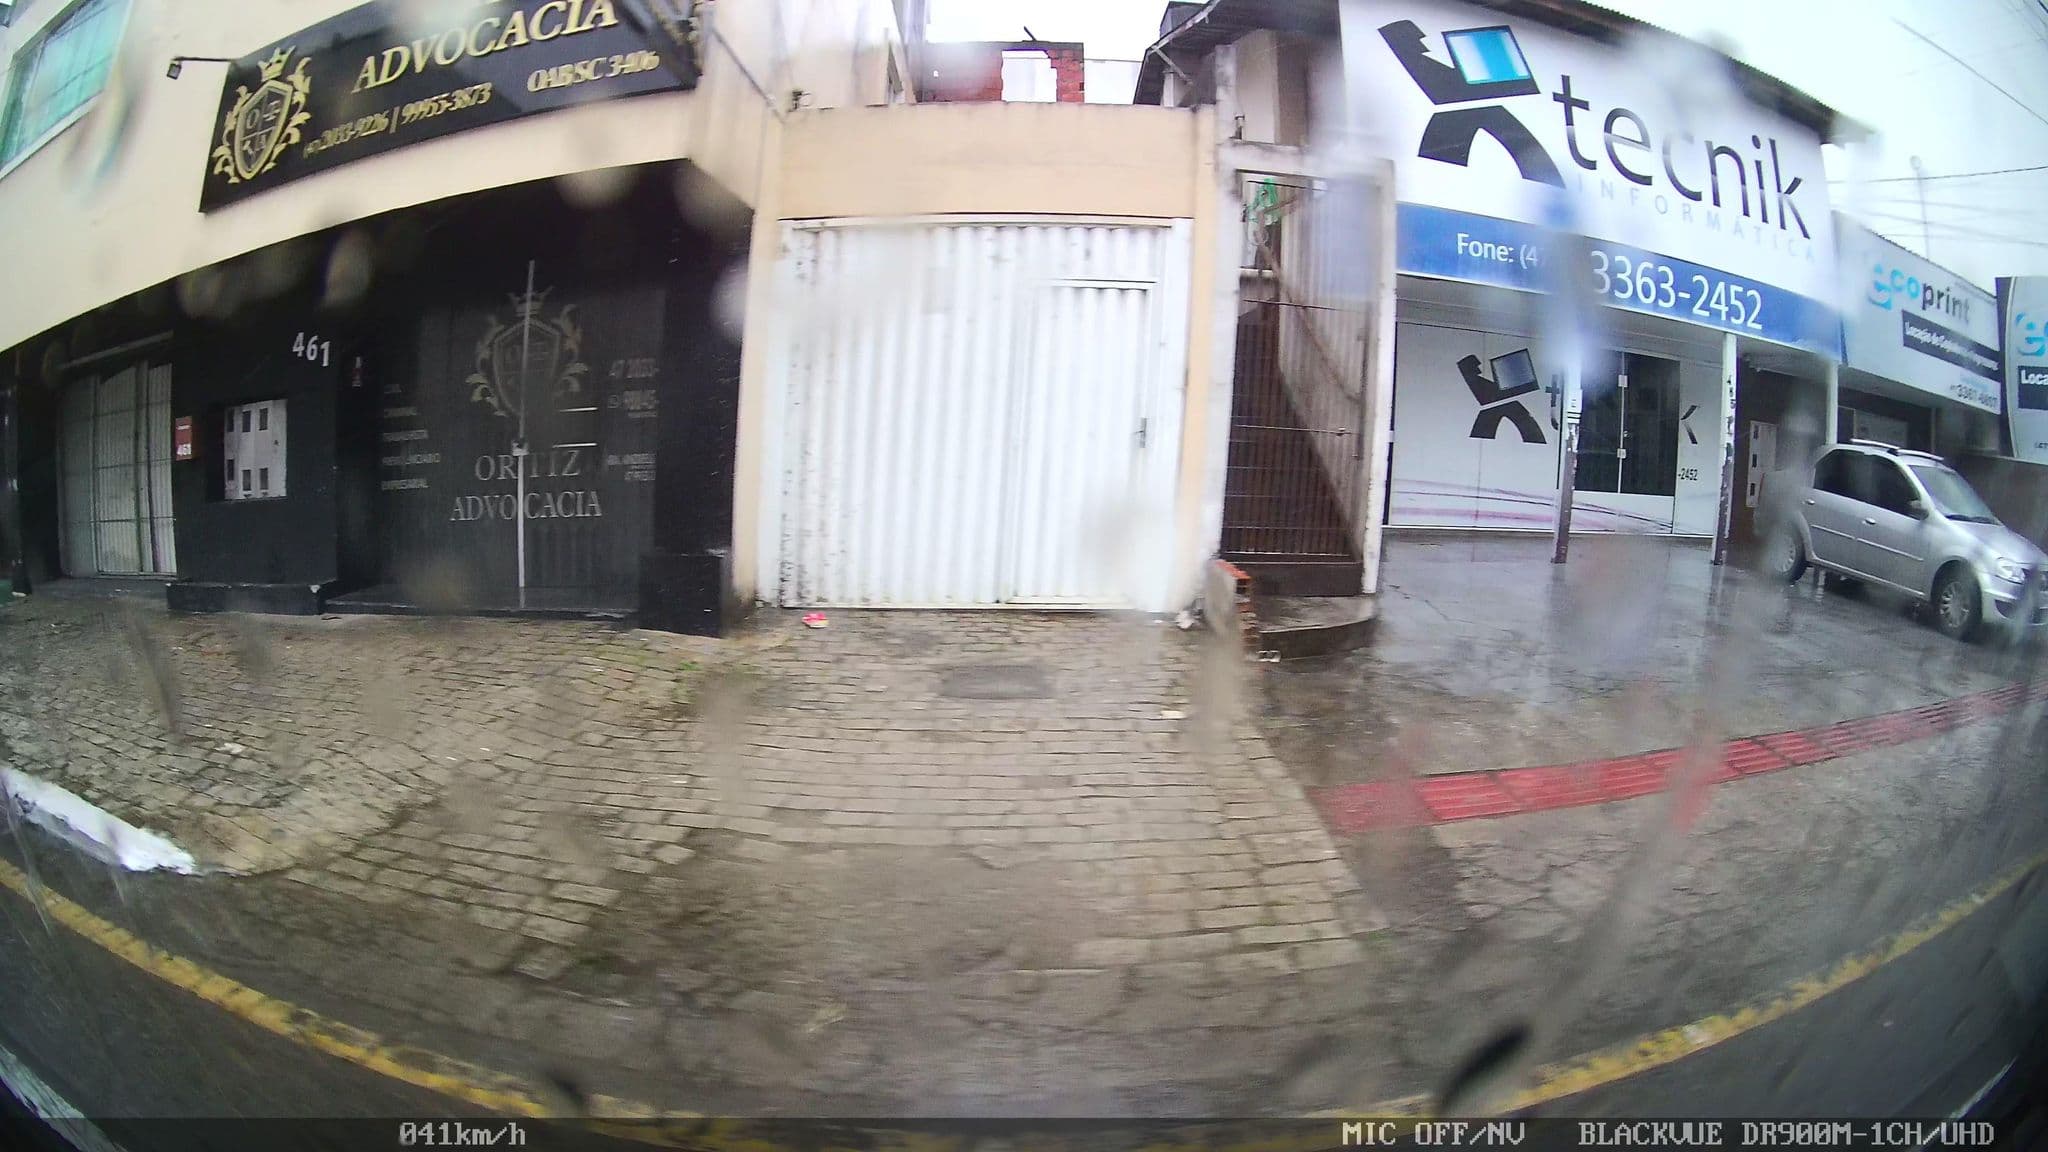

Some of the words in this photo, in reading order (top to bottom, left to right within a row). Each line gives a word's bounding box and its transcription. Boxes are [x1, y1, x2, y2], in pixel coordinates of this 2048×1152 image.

[350, 0, 620, 93] ADVOCACIA
[1552, 74, 1812, 240] tecnik
[1456, 232, 1514, 264] Fone:
[1590, 249, 1764, 332] 3363-2452
[292, 331, 331, 367] 461
[474, 450, 583, 481] ORTIZ
[450, 490, 604, 522] ADVOCACIA
